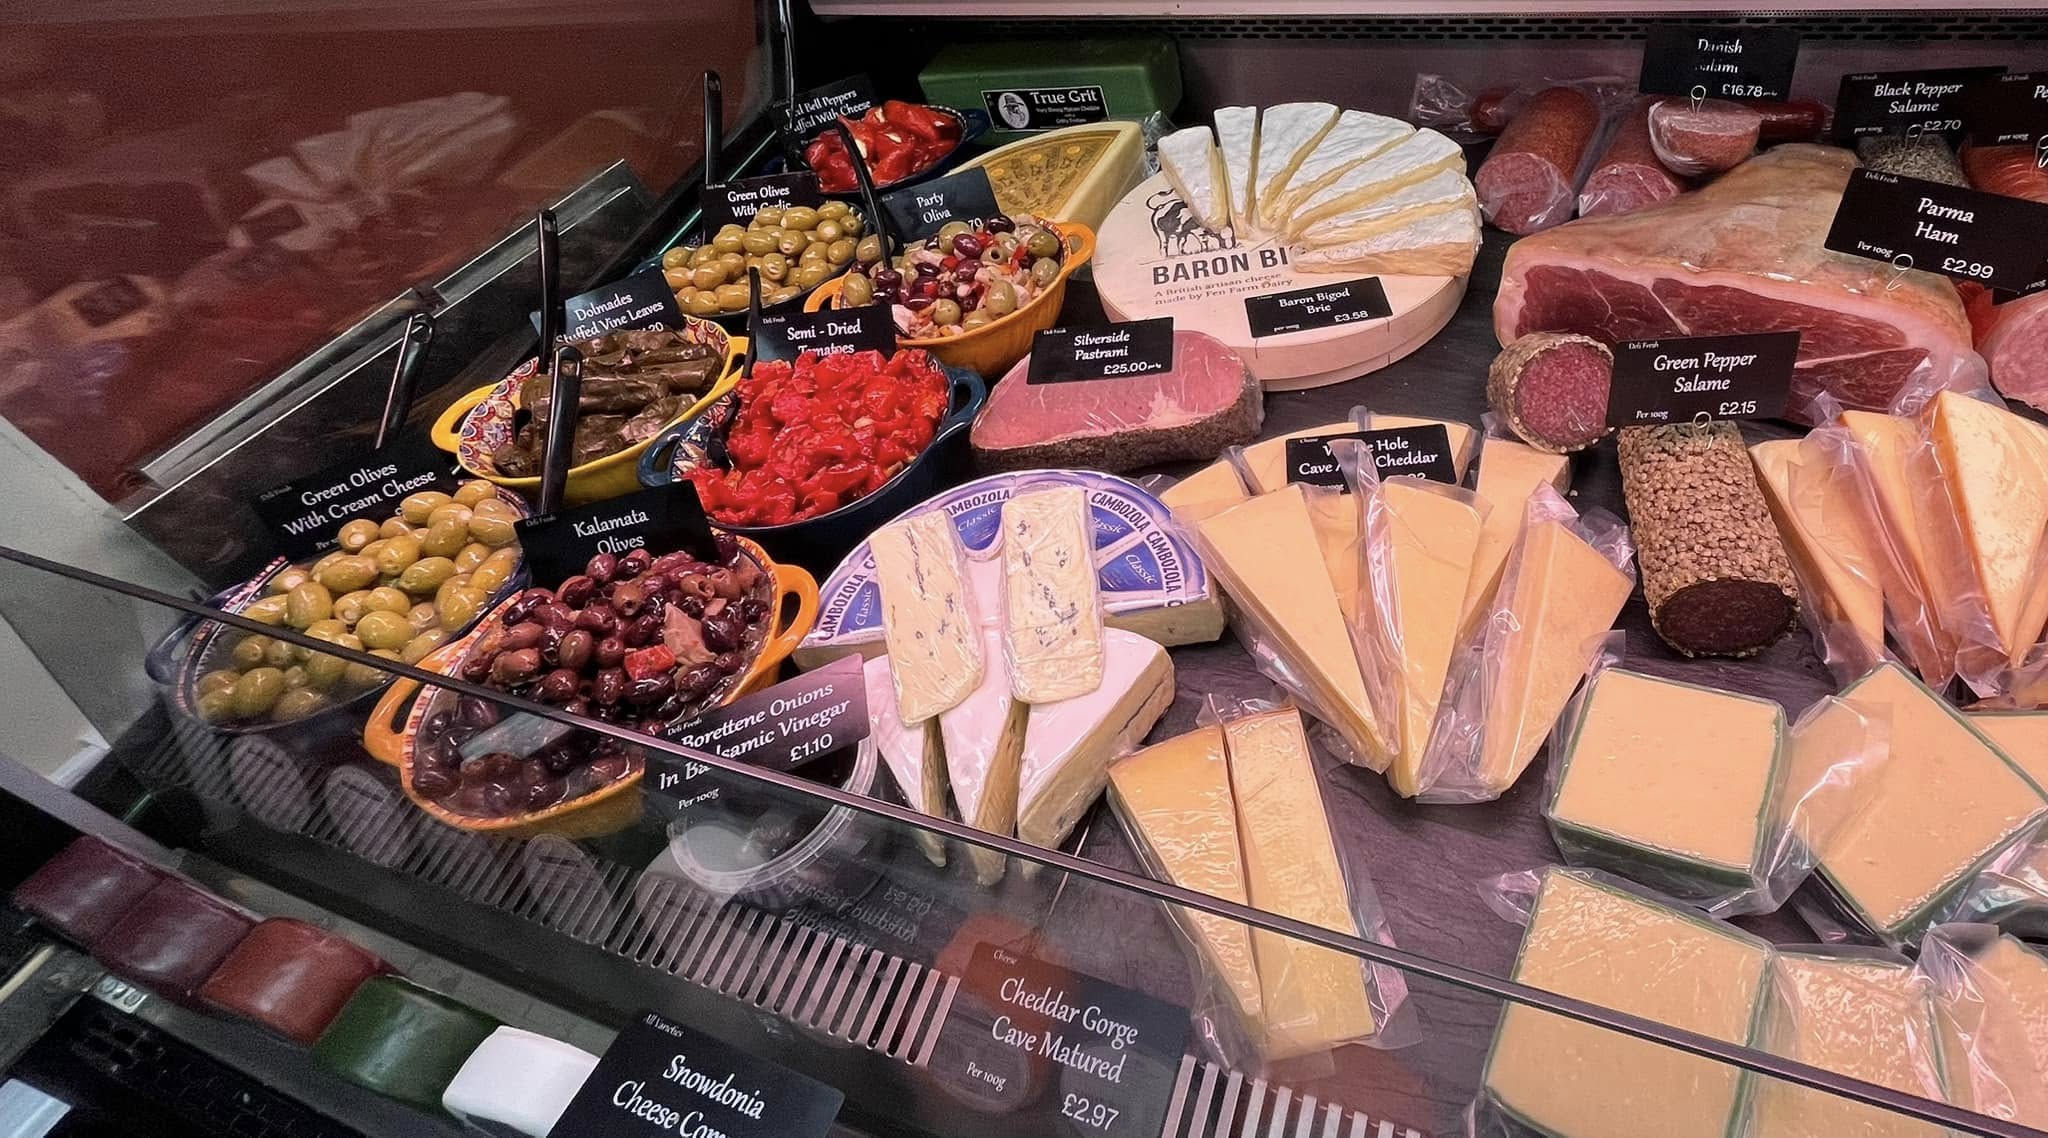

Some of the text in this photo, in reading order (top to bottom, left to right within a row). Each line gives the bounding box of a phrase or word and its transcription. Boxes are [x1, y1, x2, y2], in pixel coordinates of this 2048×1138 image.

[804, 96, 823, 113] Bell
[822, 89, 857, 107] Peppers
[1029, 89, 1098, 105] True Grit
[1722, 83, 1763, 98] £16.78
[1874, 82, 1964, 99] Black Pepper
[815, 107, 840, 124] With
[840, 100, 872, 117] Cheese
[1888, 100, 1940, 114] Salame
[1923, 119, 1962, 132] £2.70
[727, 185, 791, 203] Green Olives
[915, 193, 945, 208] Party
[731, 202, 758, 218] With
[922, 208, 953, 225] Oliva
[1916, 197, 1975, 224] Parma
[1914, 220, 1960, 245] Ham
[1856, 240, 1894, 259] Per 100g
[1153, 252, 1251, 286] BARON
[1941, 257, 1995, 280] £2.99
[1155, 278, 1294, 305] made by Fen Farm Dairy
[1166, 285, 1202, 296] British
[1204, 279, 1242, 290] artisan
[1244, 273, 1282, 283] cheese
[574, 292, 634, 322] Dolmades
[1279, 287, 1351, 308] Baron Bigod
[599, 314, 629, 331] Vine
[627, 300, 665, 321] Leaves
[1306, 304, 1332, 315] Brie
[1334, 310, 1369, 323] £3.58
[787, 326, 817, 341] Semi
[826, 318, 862, 337] Dried
[1073, 329, 1131, 347] Silverside
[1074, 345, 1129, 361] Pastrami
[1653, 352, 1758, 373] Green Pepper
[1103, 361, 1147, 375] £25.00
[1674, 373, 1731, 393] Salame
[1635, 410, 1669, 420] Per 100g
[1718, 400, 1757, 416] £2.15
[1376, 436, 1409, 451] Hole
[1299, 461, 1334, 476] Cave
[1375, 451, 1438, 468] Cheddar
[301, 462, 398, 506] Green Olives
[282, 470, 437, 536] With Cream Cheese
[1091, 491, 1151, 534] CAMBOZOLA
[573, 509, 650, 538] Kalamata
[957, 506, 998, 533] Classic
[597, 535, 646, 555] Olives
[1124, 553, 1158, 585] Classic
[1145, 530, 1182, 594] CAMBOZOLA
[818, 573, 868, 642] CAMBOZOLA
[854, 588, 873, 626] Classic
[667, 718, 703, 736] Deli Fresh
[681, 683, 834, 749] Borettene Onions
[659, 771, 680, 791] In
[779, 699, 851, 738] Vinegar
[789, 733, 834, 763] £1.10
[677, 787, 720, 811] Per 100g
[993, 949, 1018, 966] Cheese
[1000, 977, 1139, 1050] Cheddar Gorge
[654, 1016, 686, 1039] Varieties
[991, 1014, 1128, 1084] Cave Matured
[662, 1053, 766, 1120] Snowdonia
[966, 1061, 1008, 1093] Per 100g
[612, 1079, 681, 1130] Cheese
[1061, 1092, 1121, 1131] £2.97
